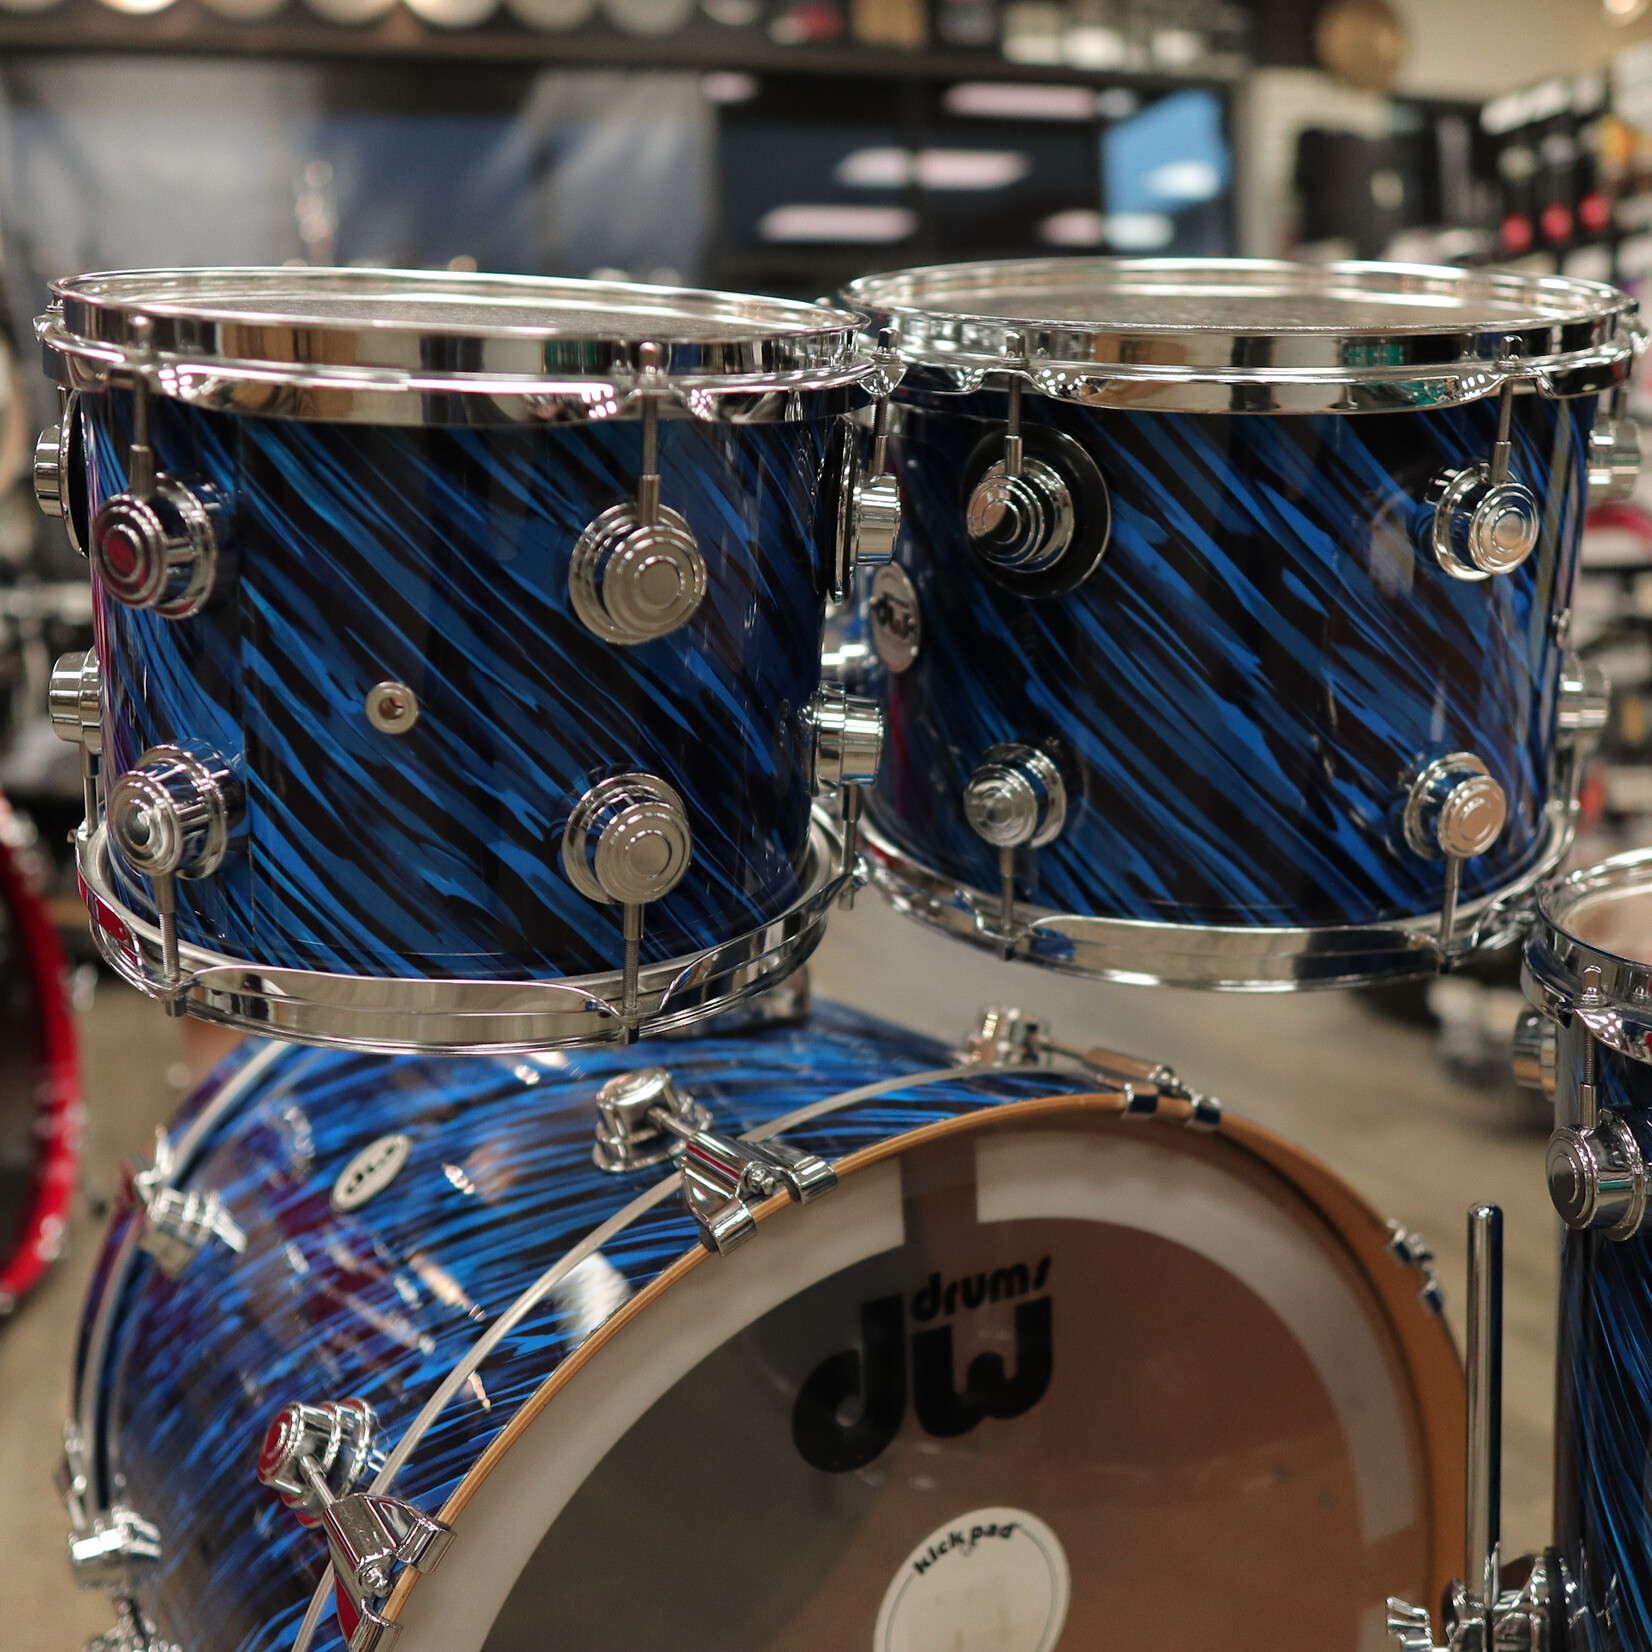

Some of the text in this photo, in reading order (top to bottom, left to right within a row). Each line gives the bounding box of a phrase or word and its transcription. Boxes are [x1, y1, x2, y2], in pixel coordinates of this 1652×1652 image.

[911, 1255, 1052, 1322] drums
[792, 1292, 1053, 1474] dw
[914, 1522, 1020, 1575] kick pad
